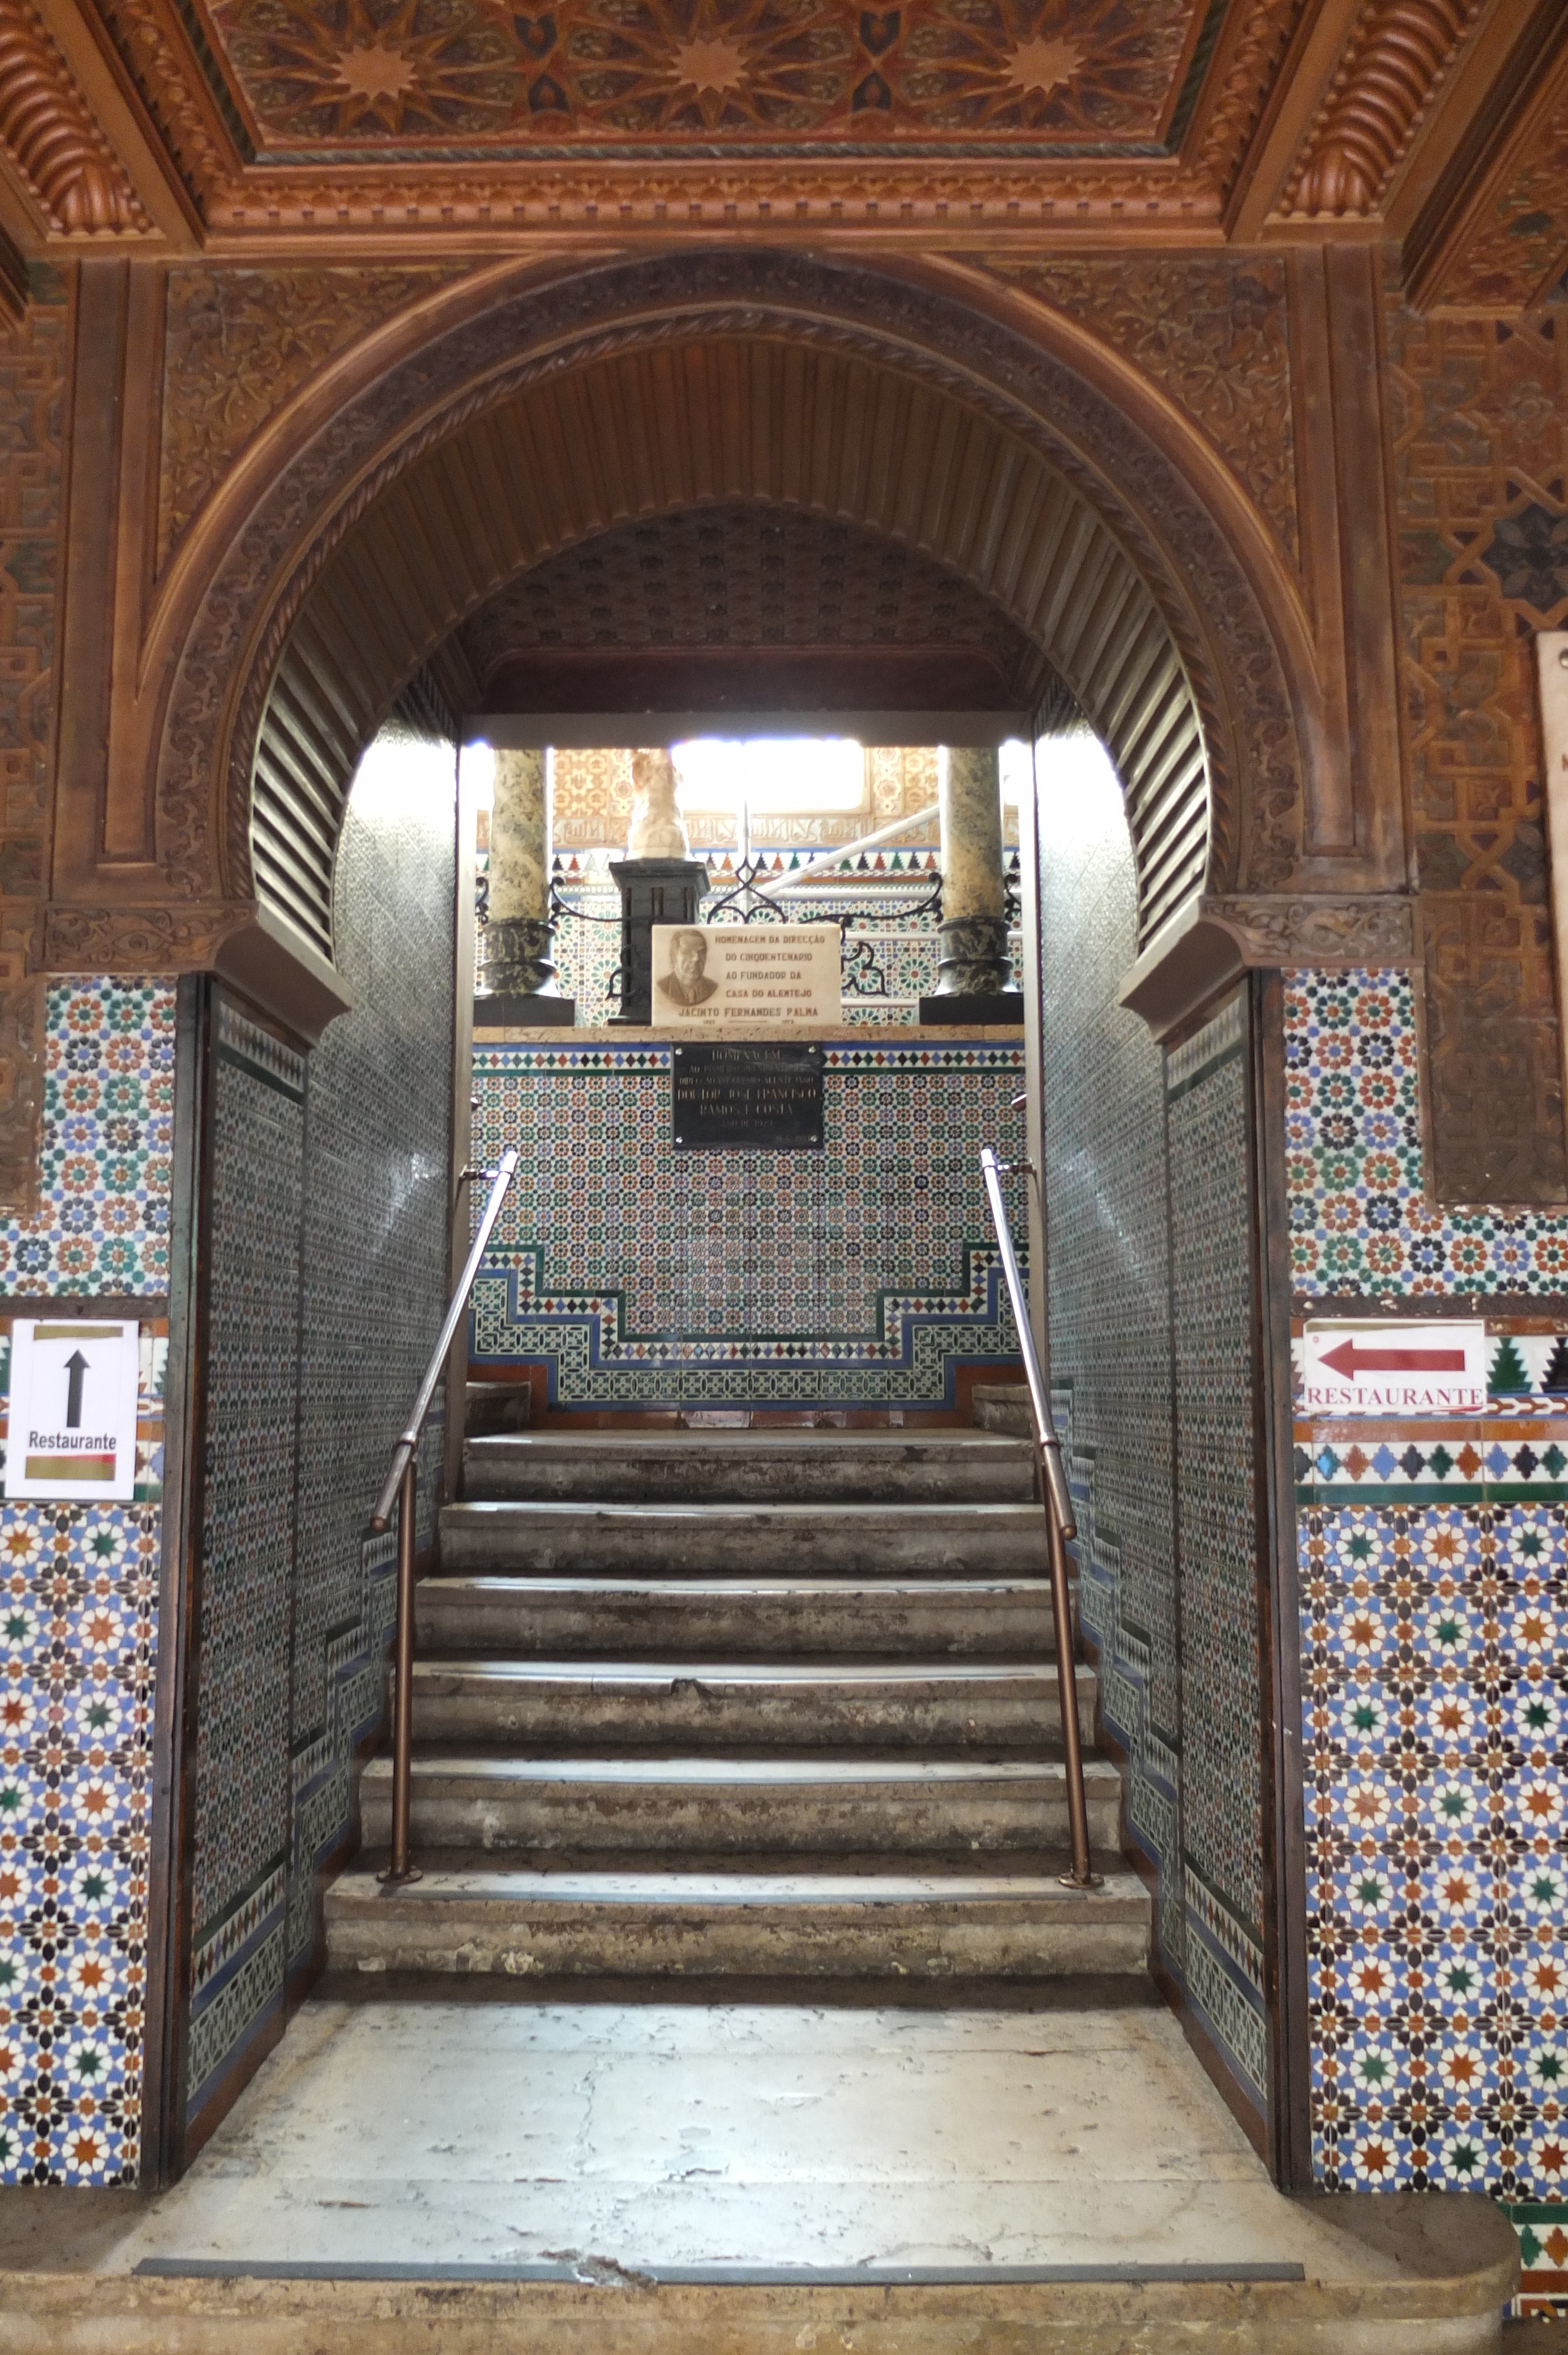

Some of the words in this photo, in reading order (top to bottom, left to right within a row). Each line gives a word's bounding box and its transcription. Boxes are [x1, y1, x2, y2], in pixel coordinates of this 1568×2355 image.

[715, 935, 766, 944] HOMENAGEM
[769, 935, 780, 944] DA
[725, 953, 737, 961] DO
[726, 971, 737, 980] AO
[740, 971, 787, 980] FUNDADOR
[790, 971, 802, 980] DA
[726, 989, 749, 997] CASA
[752, 989, 764, 997] DO
[768, 989, 812, 998] ALENTEJO
[679, 1007, 720, 1017] JACINTO
[724, 1007, 781, 1017] FERNANDES
[786, 1007, 818, 1016] PALMA
[756, 1103, 793, 1116] COSTA
[1307, 1387, 1483, 1405] RESTAURANTE
[28, 1431, 117, 1450] Restaurante
